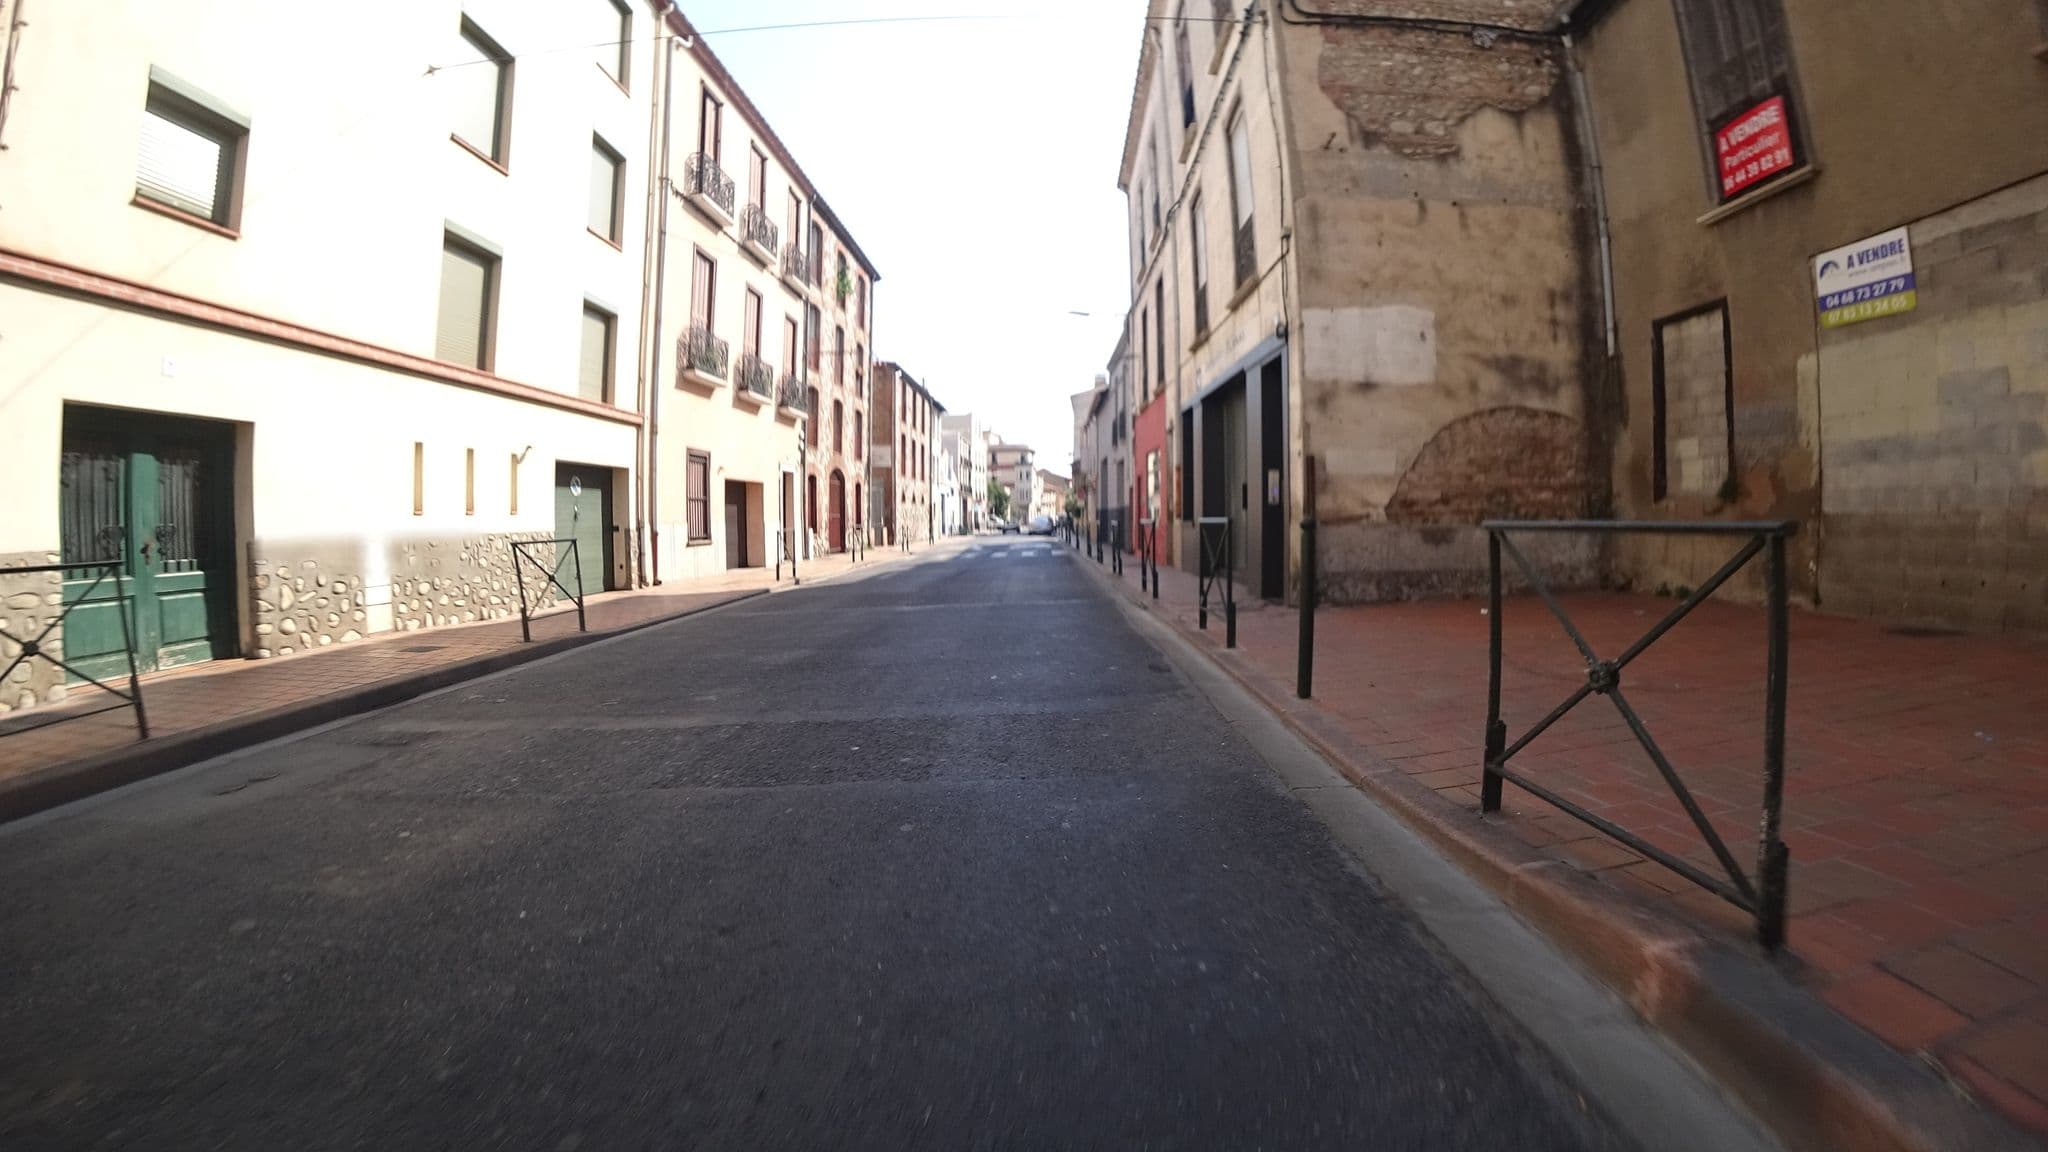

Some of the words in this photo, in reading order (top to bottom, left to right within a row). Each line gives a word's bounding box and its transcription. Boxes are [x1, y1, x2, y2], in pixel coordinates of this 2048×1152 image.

[1720, 136, 1729, 153] A
[1728, 104, 1780, 146] VENDRE
[1846, 254, 1855, 269] A
[1857, 238, 1905, 265] VENDRE
[1826, 294, 1840, 308] 04
[1841, 290, 1855, 305] 68
[1856, 286, 1871, 301] 73
[1872, 281, 1887, 297] 27
[1889, 277, 1905, 291] 79
